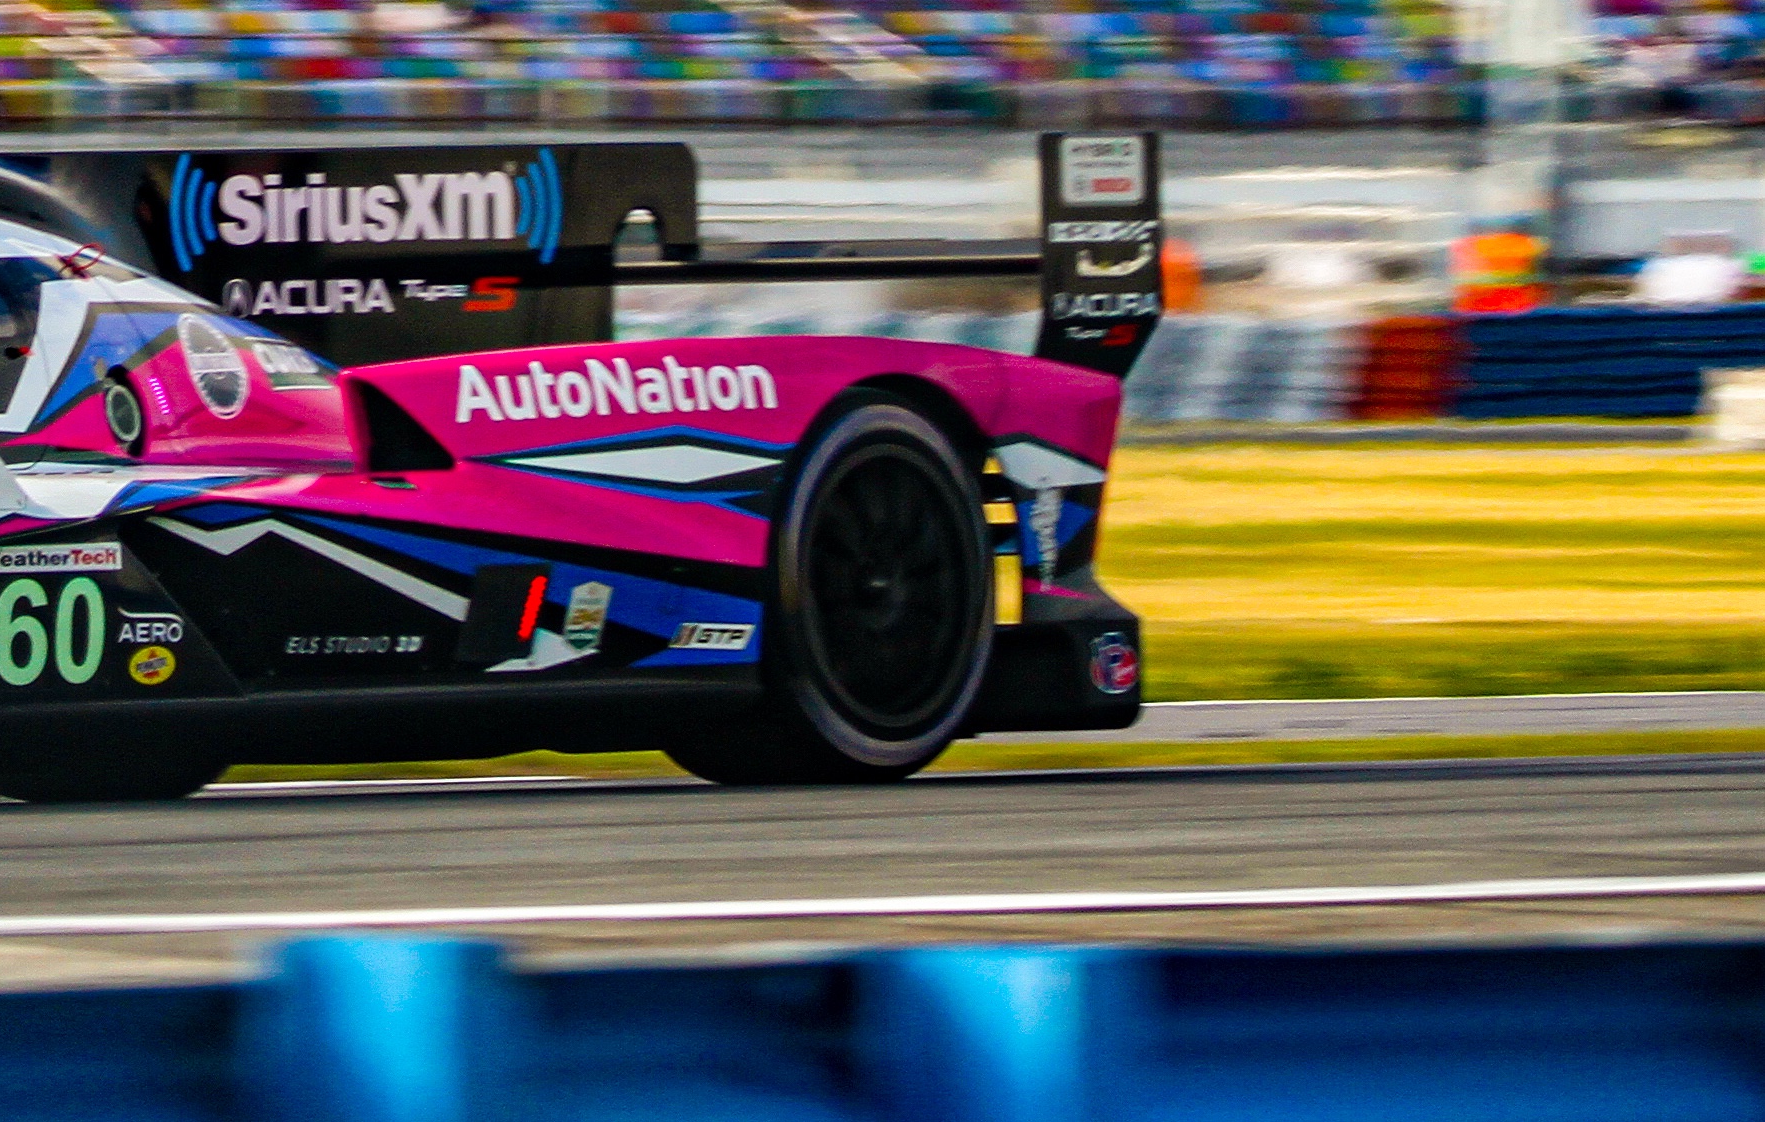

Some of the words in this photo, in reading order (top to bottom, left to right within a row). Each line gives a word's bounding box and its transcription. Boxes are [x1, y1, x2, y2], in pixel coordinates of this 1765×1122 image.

[253, 279, 395, 315] ACURA
[461, 277, 521, 312] S
[455, 355, 778, 423] AutoNation
[117, 622, 183, 644] AERO
[286, 636, 321, 654] ELS
[323, 636, 391, 654] STUDIO
